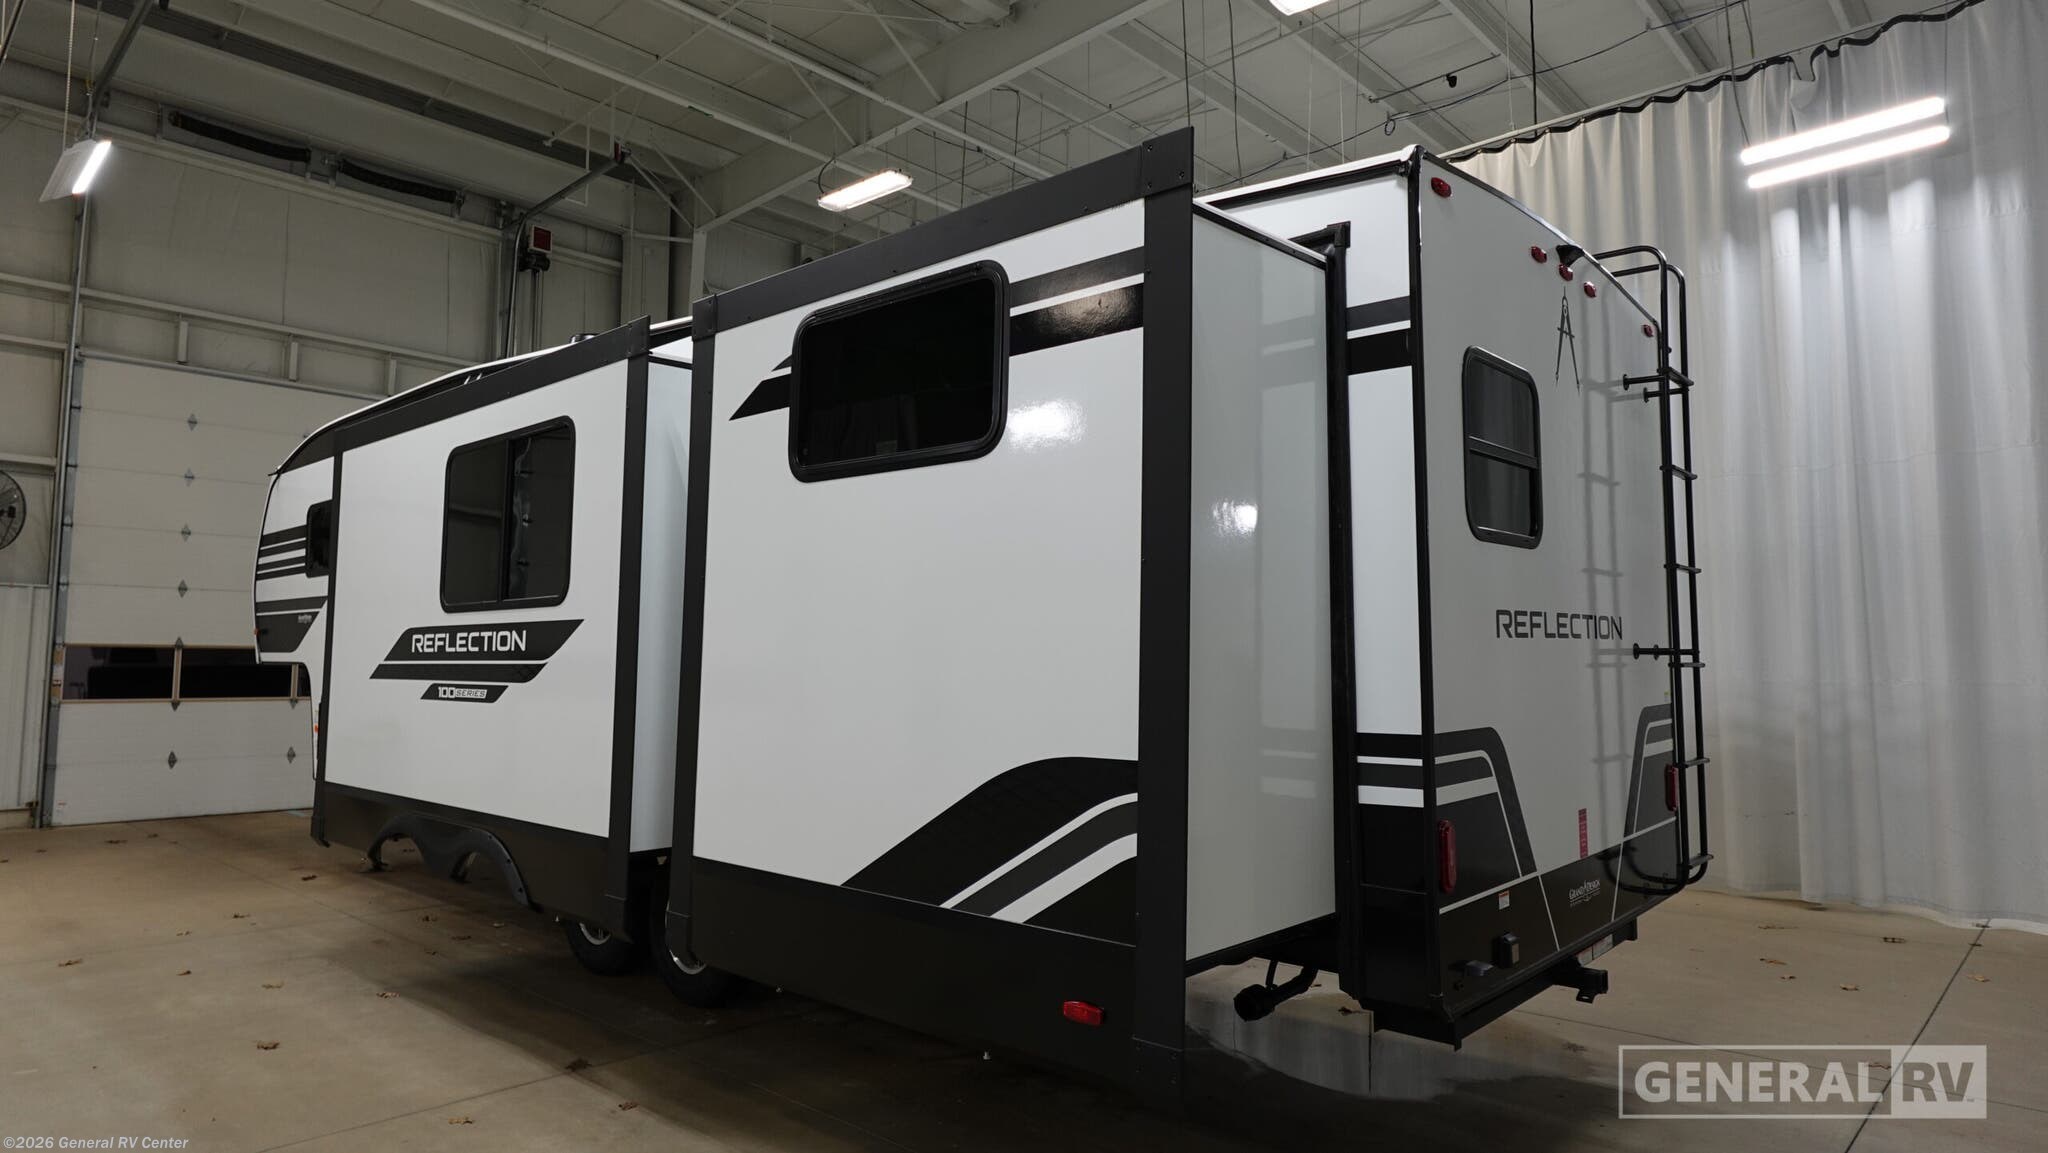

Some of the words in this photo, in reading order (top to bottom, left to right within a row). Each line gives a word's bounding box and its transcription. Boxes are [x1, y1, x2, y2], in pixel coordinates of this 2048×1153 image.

[1495, 609, 1623, 640] REFLECTION
[411, 629, 527, 653] REFLECTION
[438, 686, 456, 699] 100
[456, 689, 486, 698] SERIES
